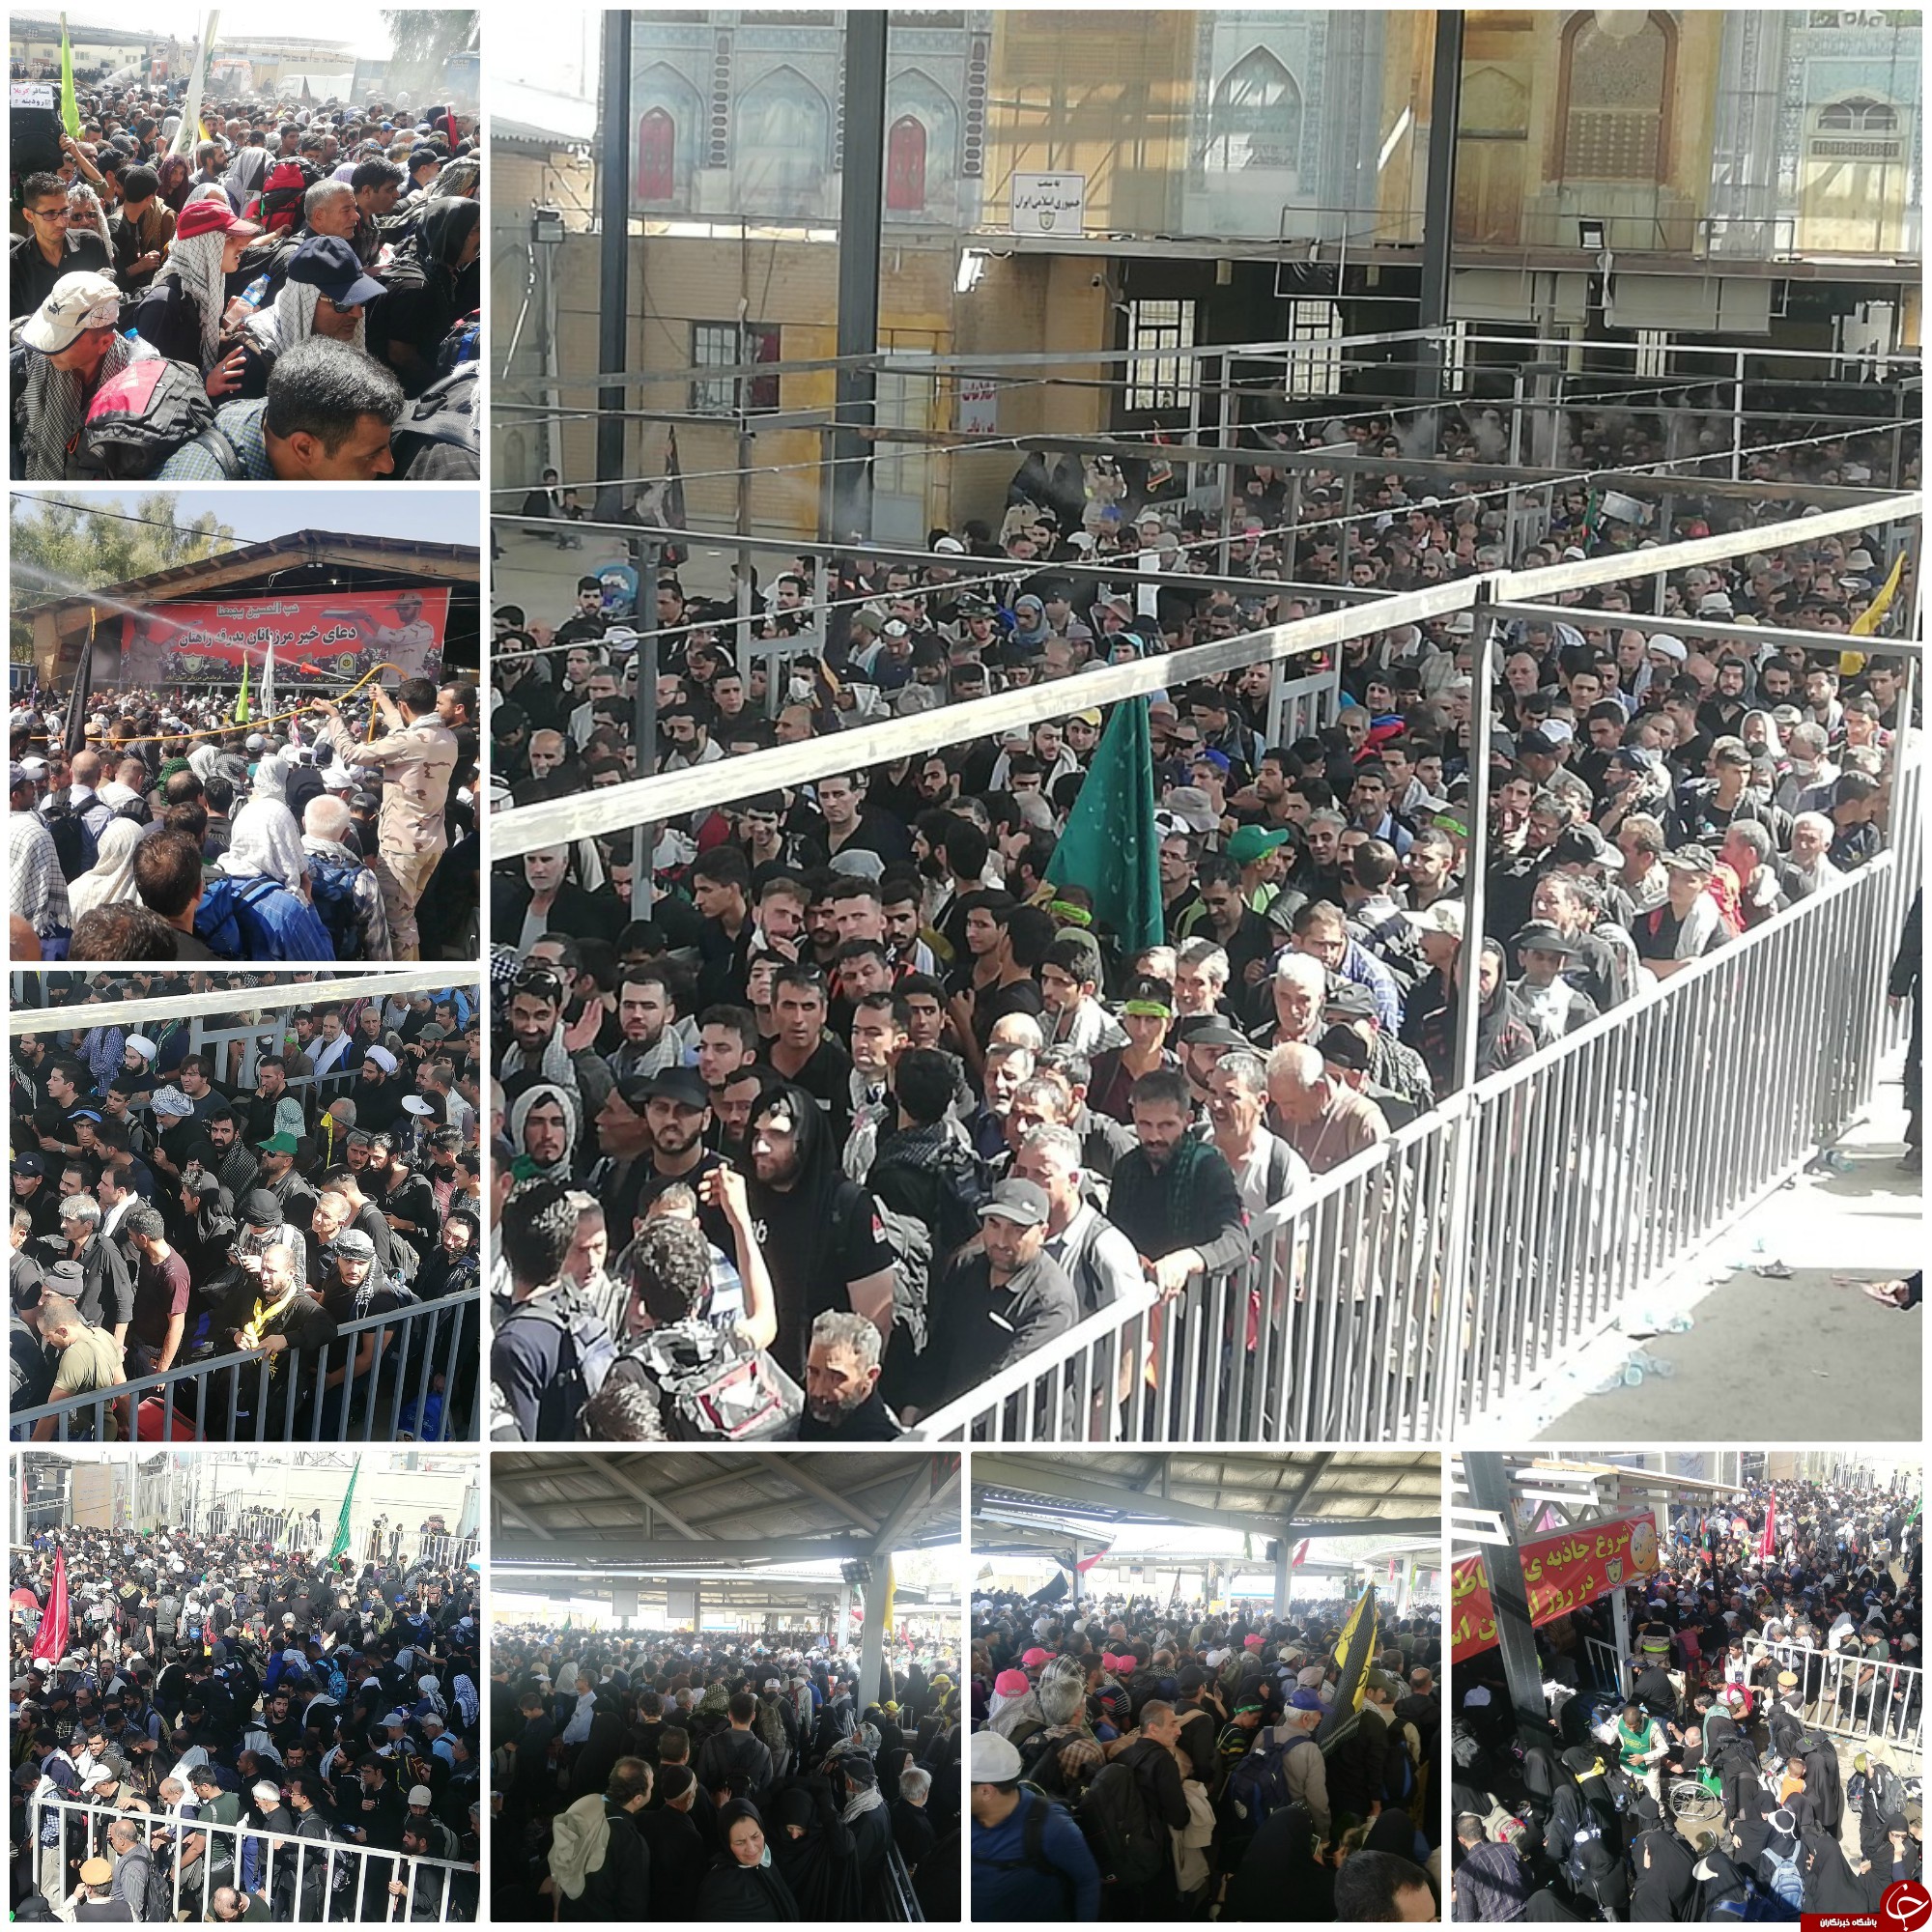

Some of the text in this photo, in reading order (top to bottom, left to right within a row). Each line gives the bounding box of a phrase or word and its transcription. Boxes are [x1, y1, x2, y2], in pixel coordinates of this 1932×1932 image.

[1015, 196, 1080, 211] جمهوری اسلامی ایران
[283, 604, 299, 616] حب
[179, 624, 357, 648] دعای خیر مرزبانان بدرقه راهتان
[1595, 1525, 1630, 1559] شروع
[1546, 1538, 1590, 1572] جاذبه
[1524, 1557, 1543, 1582] ی
[1578, 1575, 1595, 1602] در
[1546, 1590, 1575, 1615] روز
